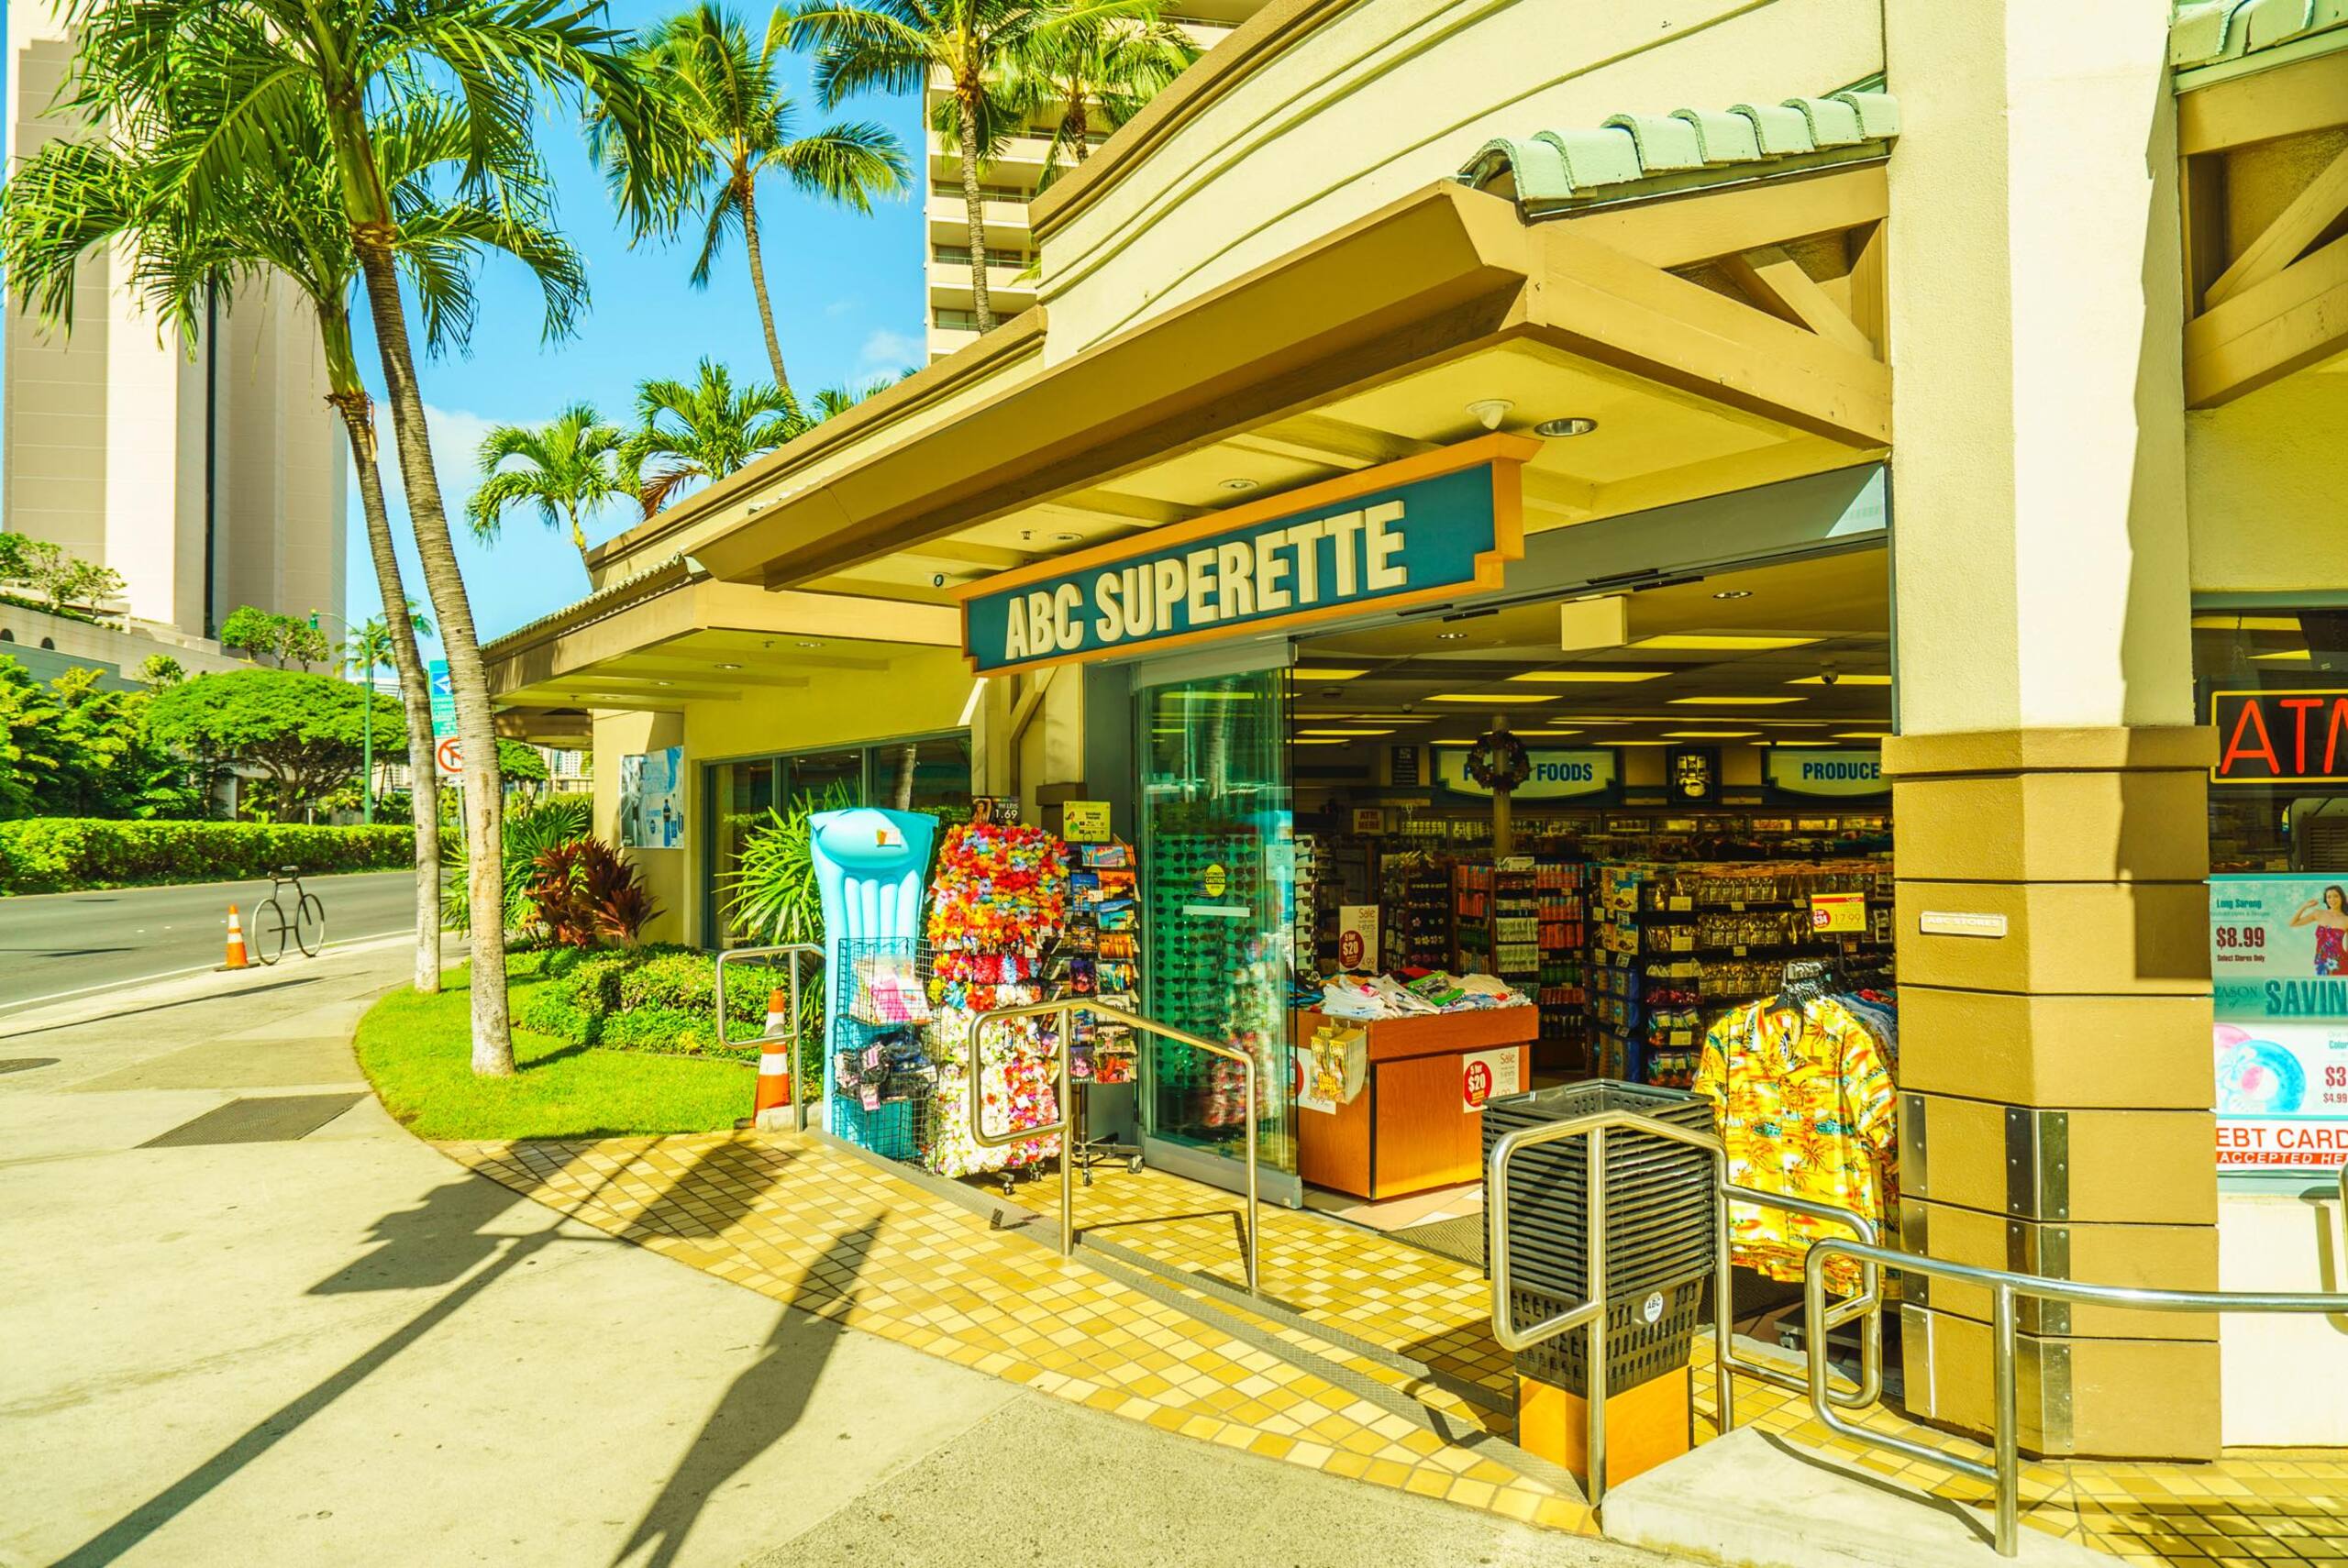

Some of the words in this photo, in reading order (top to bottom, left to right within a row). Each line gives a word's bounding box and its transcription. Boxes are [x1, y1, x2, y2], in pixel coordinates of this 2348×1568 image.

[1005, 581, 1083, 660] ABC
[1095, 500, 1407, 643] SUPERETTE
[1536, 763, 1593, 781] FOODS
[1802, 762, 1880, 779] PRODUCE
[995, 809, 1018, 819] 1.69
[1358, 908, 1376, 919] Sale
[1834, 913, 1861, 924] 17.99
[2216, 924, 2265, 950] $8.99
[1343, 941, 1359, 955] $20
[2212, 985, 2258, 999] EASON
[1501, 1053, 1515, 1065] Sale
[1468, 1073, 1486, 1093] $20
[2323, 1091, 2348, 1103] $4.99
[2220, 1152, 2313, 1164] ACCEPTED
